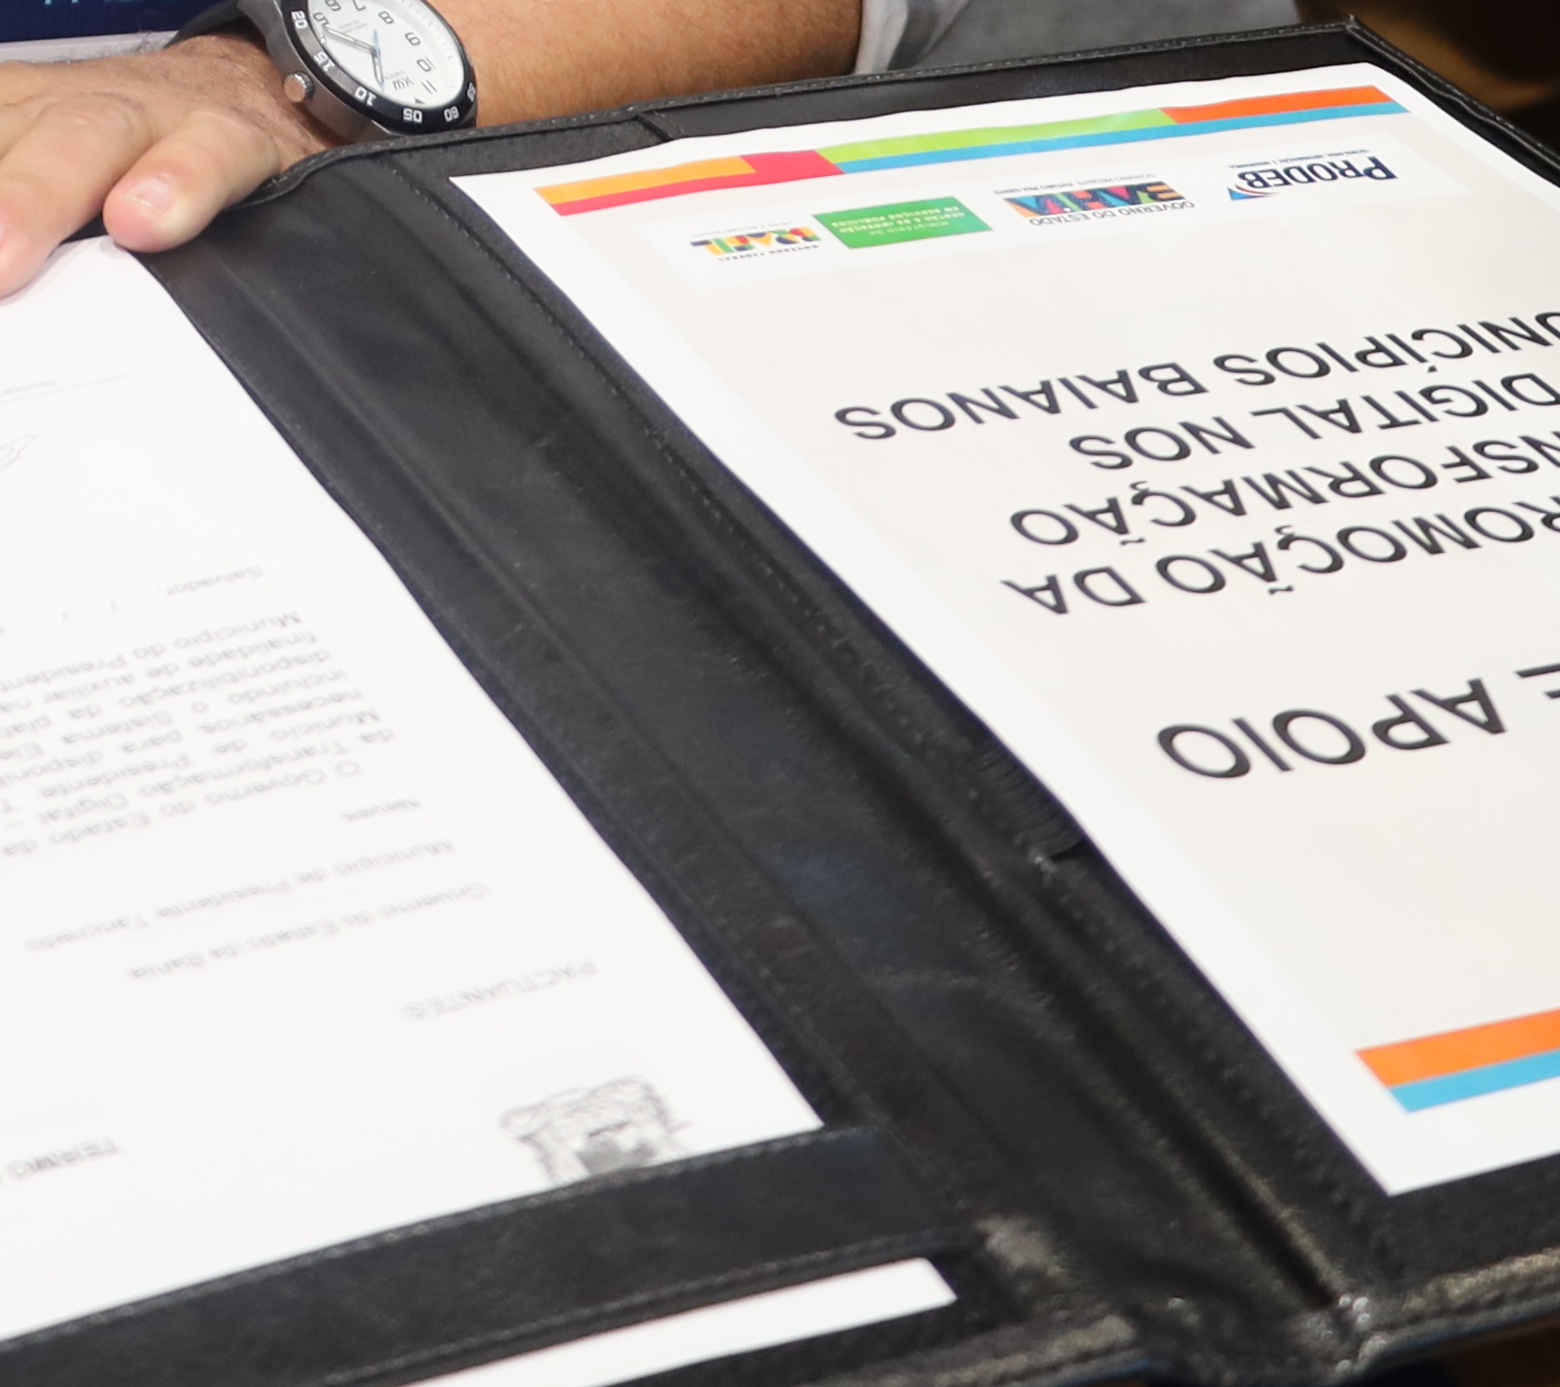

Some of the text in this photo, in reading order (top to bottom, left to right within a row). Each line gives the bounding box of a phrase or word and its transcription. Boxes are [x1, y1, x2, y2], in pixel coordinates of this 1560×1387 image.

[291, 11, 308, 28] 20
[378, 11, 394, 24] 8
[313, 52, 335, 71] 15
[355, 87, 377, 106] 10
[403, 107, 423, 123] 05
[1233, 155, 1398, 189] PRODEB
[1026, 199, 1196, 225] GOVERNO DO ESTADO
[688, 225, 821, 255] BRASIL
[834, 363, 1208, 440] BAIANOS
[1069, 417, 1255, 470] NOS
[1002, 566, 1145, 615] DA
[1157, 678, 1506, 779] APOIO
